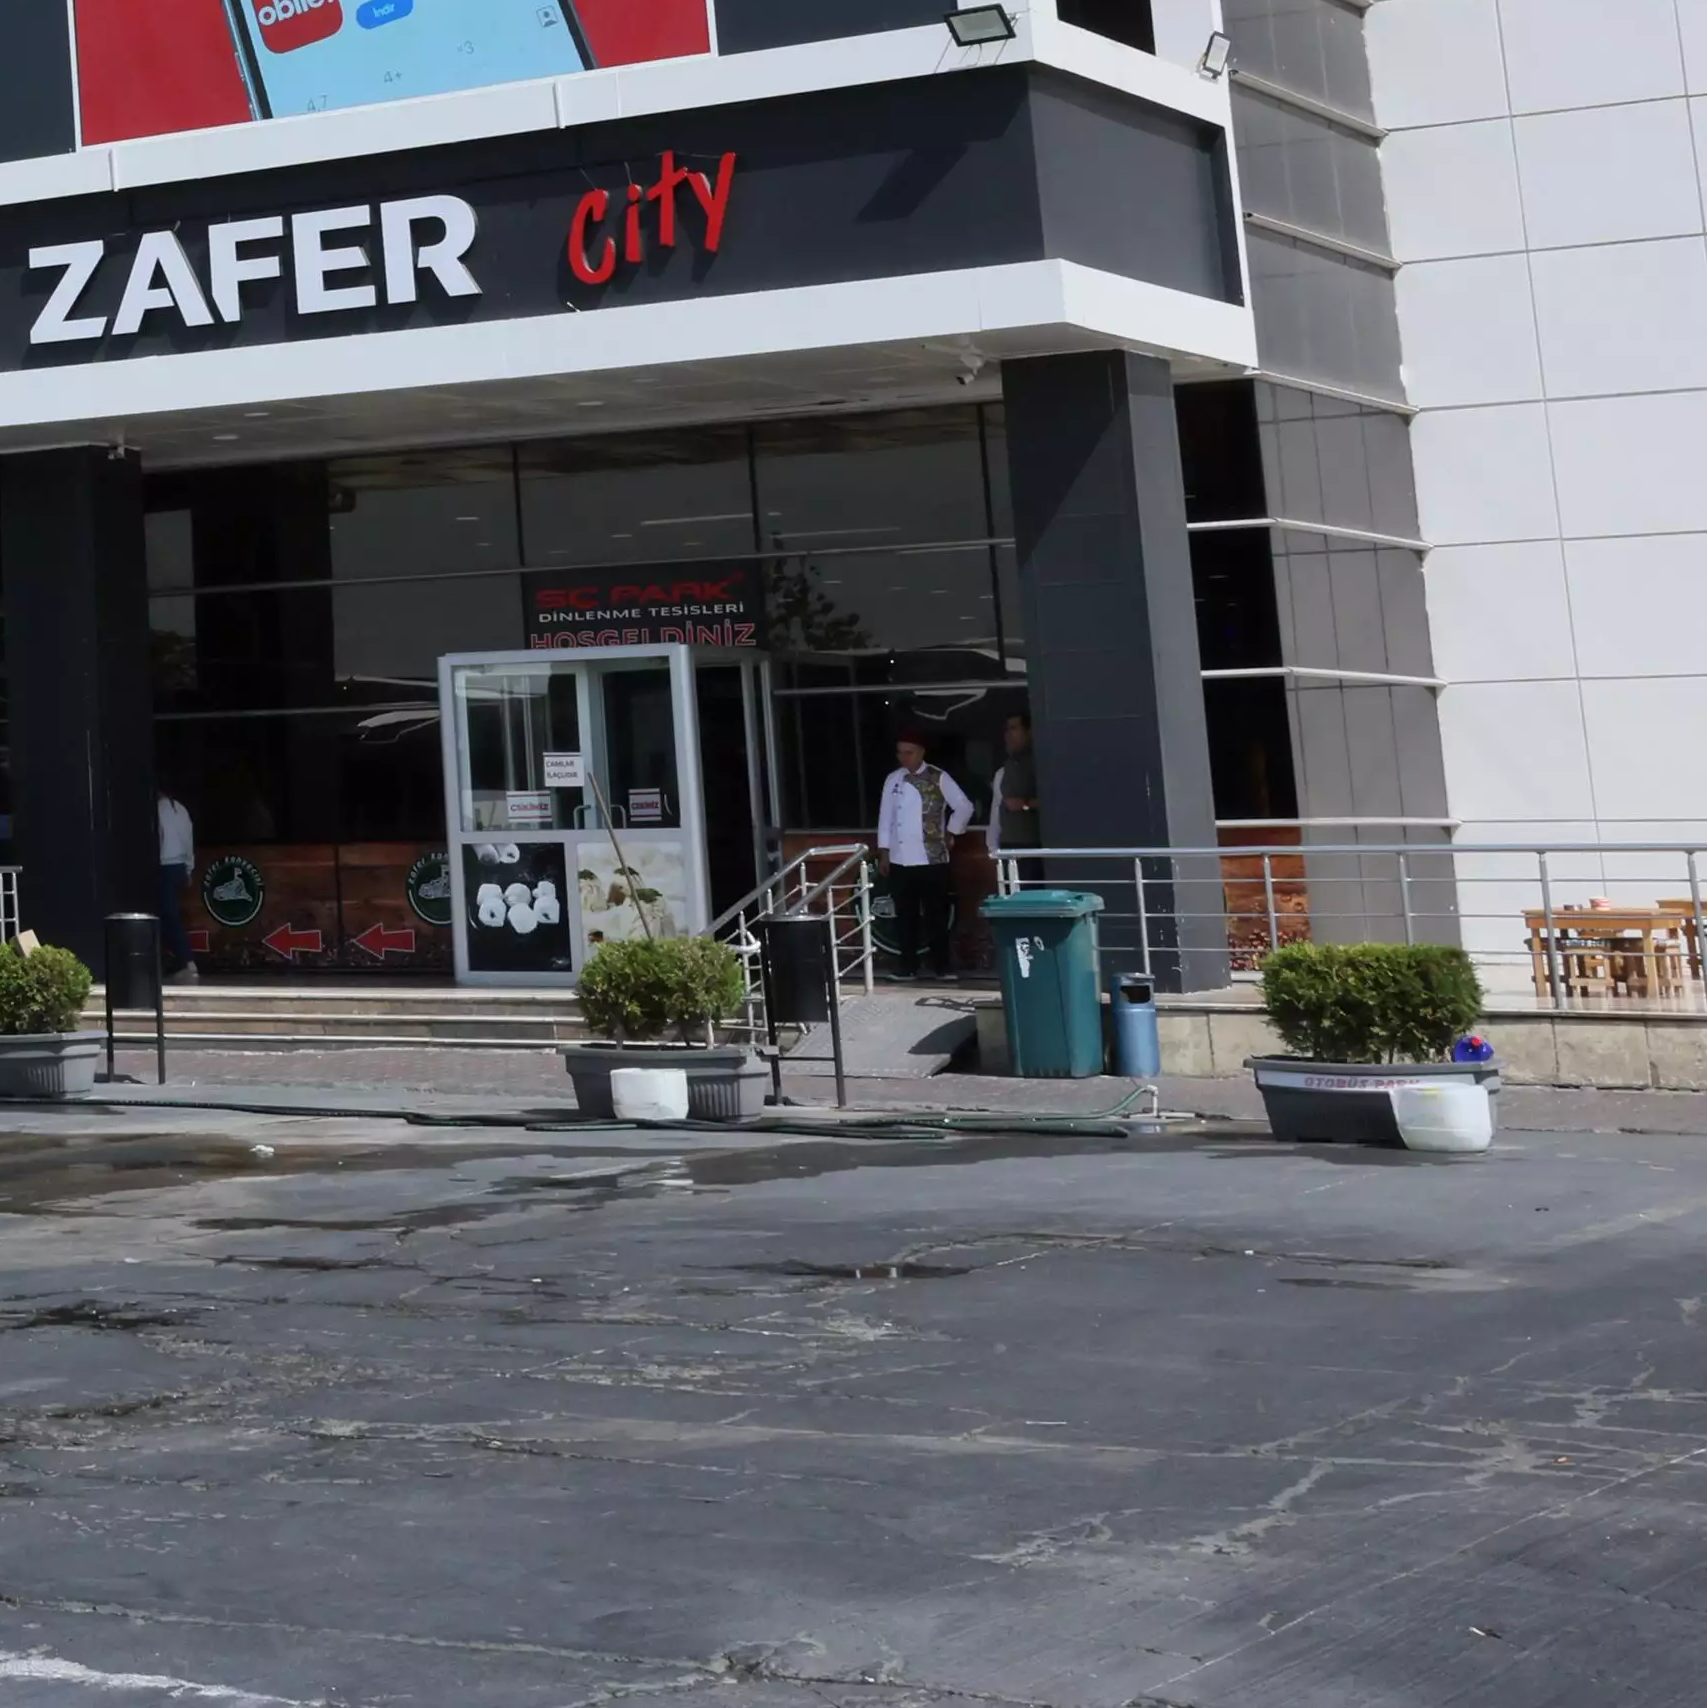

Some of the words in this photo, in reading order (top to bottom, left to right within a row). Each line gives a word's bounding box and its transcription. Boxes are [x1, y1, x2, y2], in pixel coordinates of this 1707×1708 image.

[27, 193, 484, 345] ZAFER
[538, 608, 642, 623] DİNLENME
[648, 600, 745, 618] TESİSLERİ
[1304, 1076, 1368, 1089] OTOBÜS
